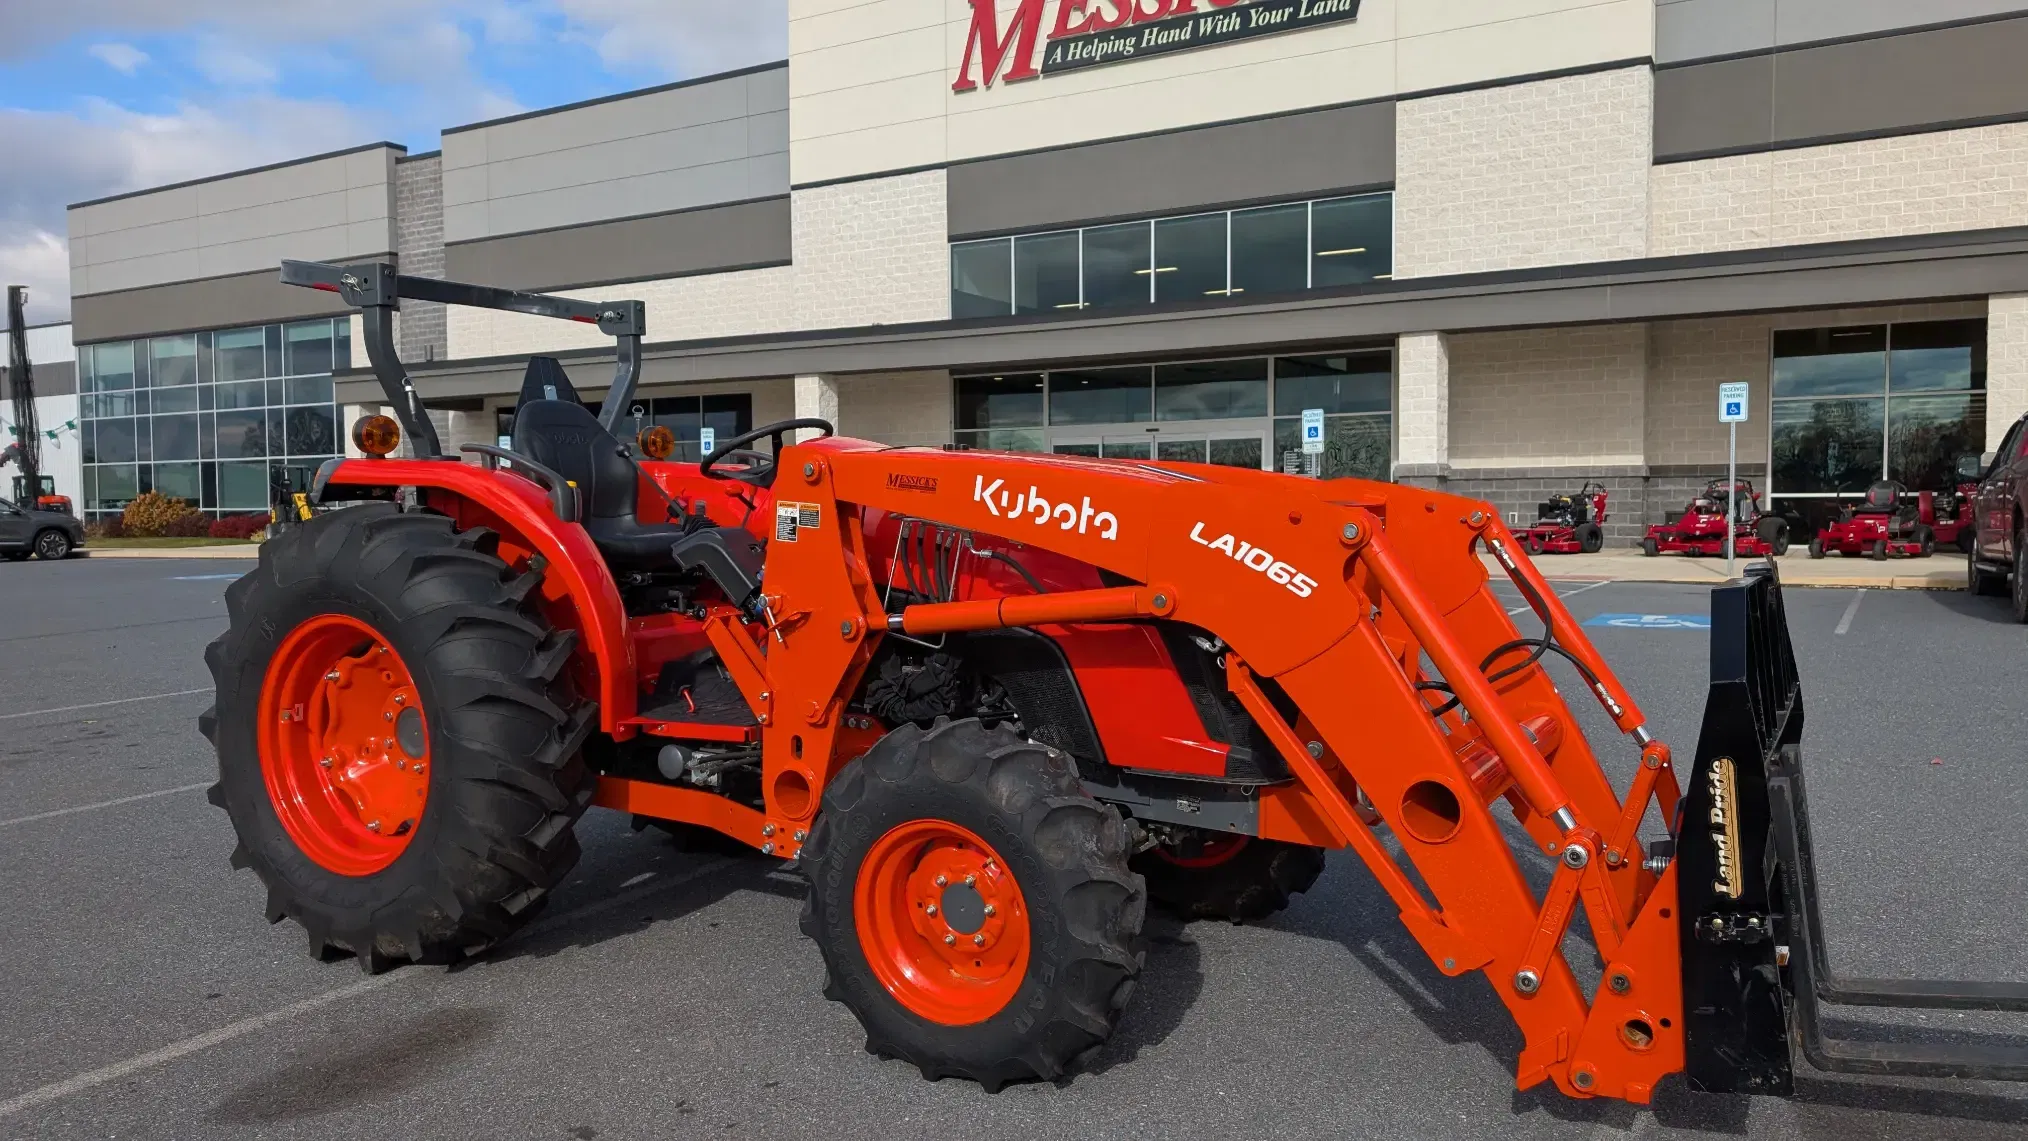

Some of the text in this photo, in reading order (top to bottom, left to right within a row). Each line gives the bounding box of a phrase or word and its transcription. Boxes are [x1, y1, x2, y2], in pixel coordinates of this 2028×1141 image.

[1048, 0, 1352, 64] A Helping Hand With Your Land
[886, 473, 938, 487] MESSICK'S
[973, 475, 1118, 541] Kubota
[1189, 521, 1319, 598] LA1065
[1709, 759, 1737, 898] Land Pride
